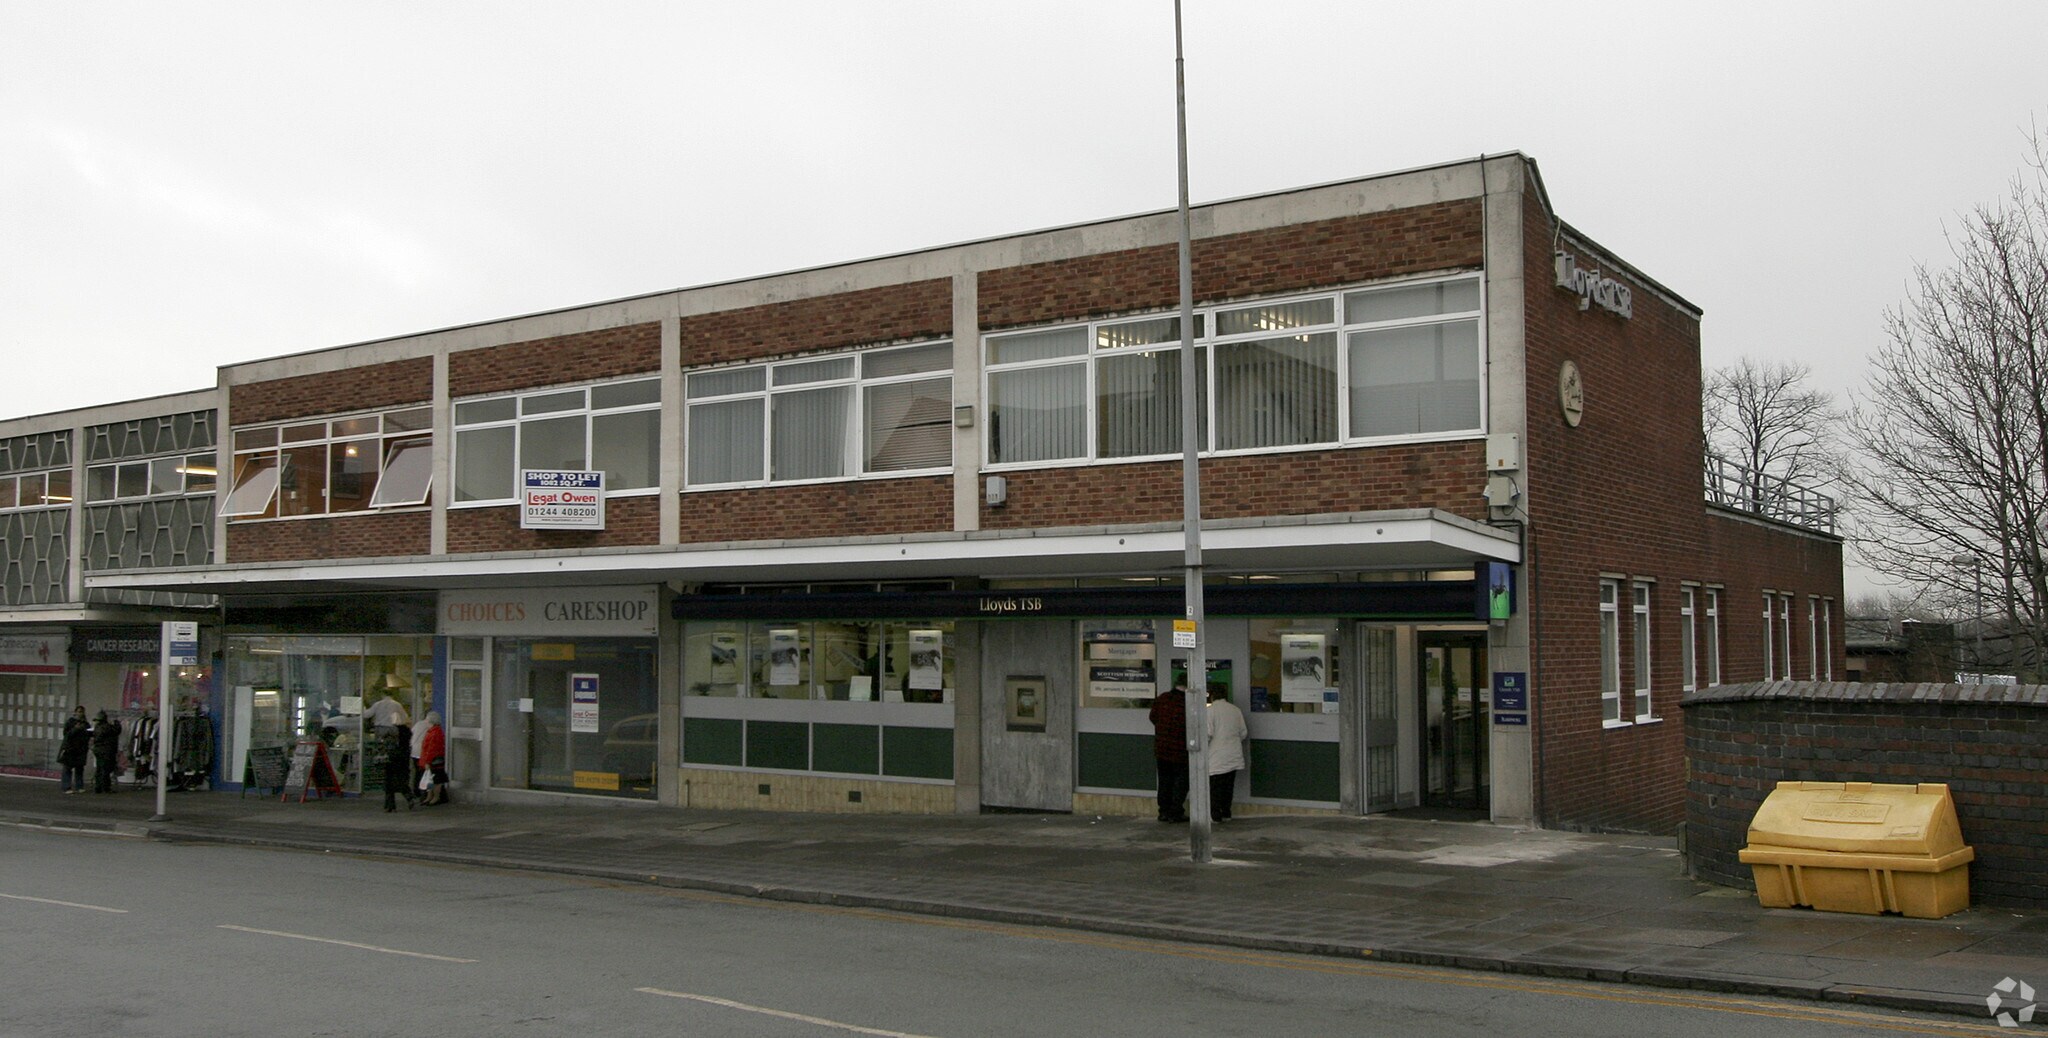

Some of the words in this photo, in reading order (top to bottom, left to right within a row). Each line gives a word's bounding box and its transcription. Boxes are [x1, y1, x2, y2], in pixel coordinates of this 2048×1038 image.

[528, 492, 557, 505] Legat
[561, 492, 596, 503] Owen
[528, 507, 557, 515] 01244
[561, 508, 597, 516] 408200
[447, 602, 525, 622] CHOICES
[544, 601, 648, 621] CARESHOP
[980, 597, 1017, 615] Lloyds
[1019, 597, 1042, 610] TSB
[87, 640, 117, 651] CANCER
[119, 640, 160, 651] RESEARCH
